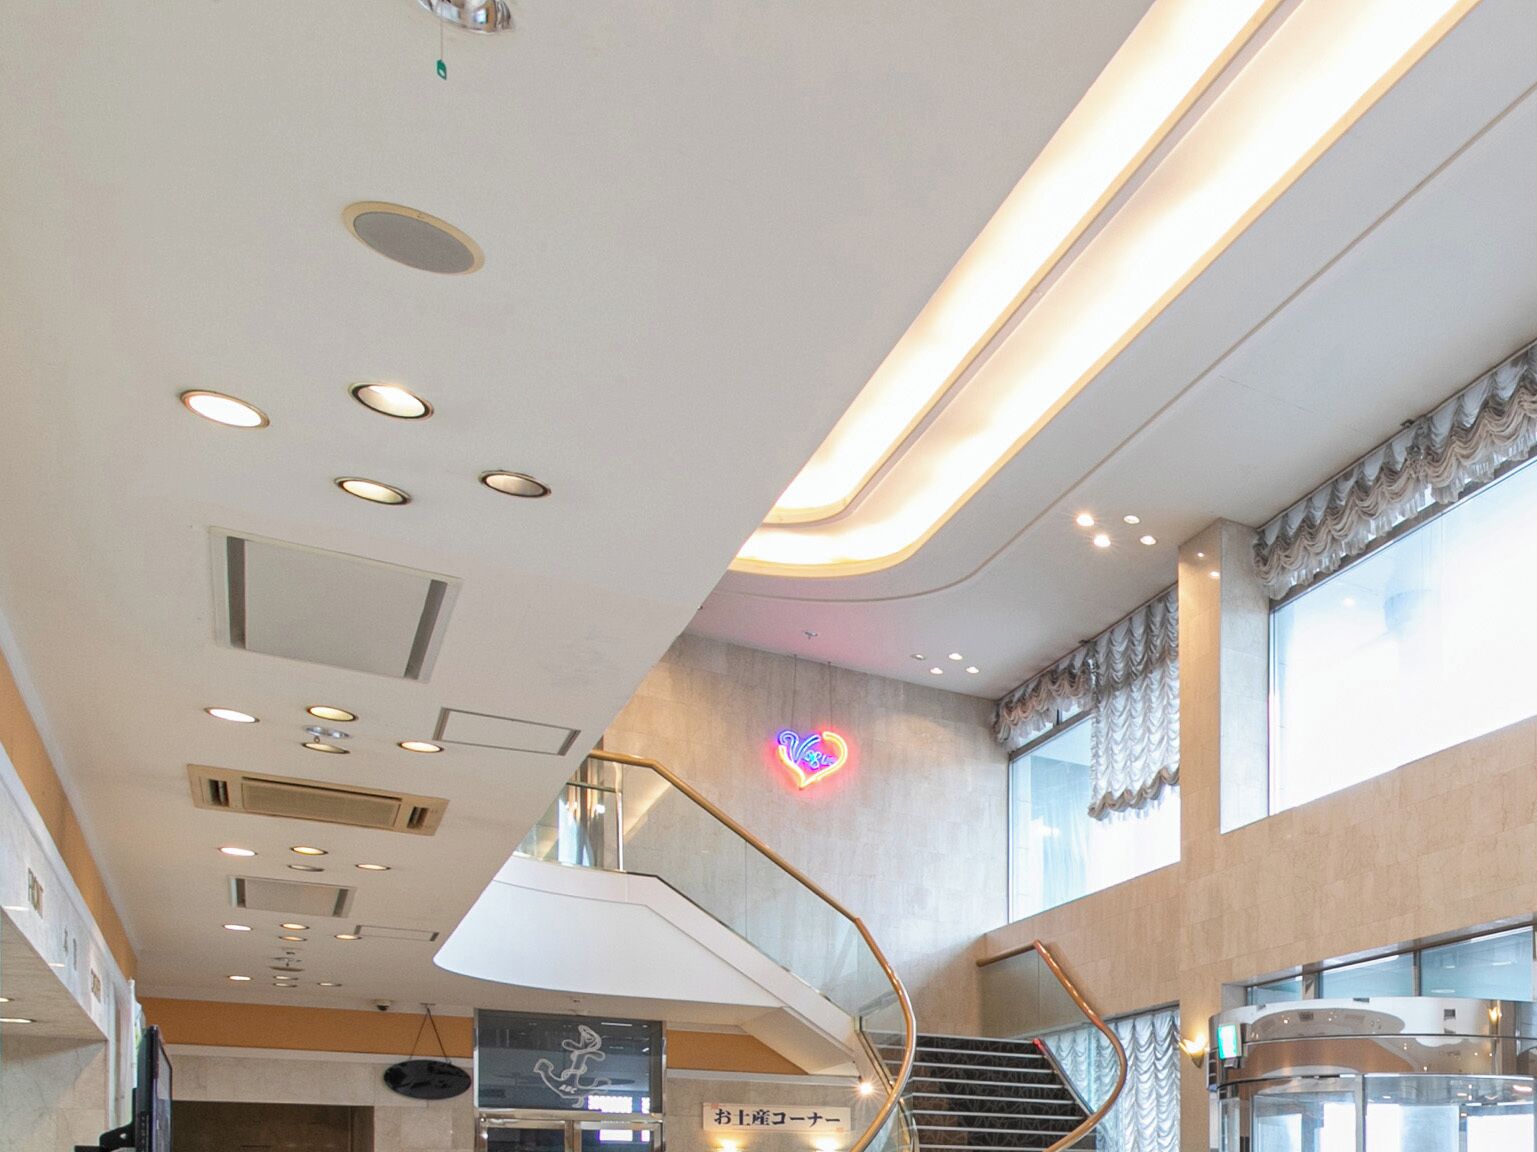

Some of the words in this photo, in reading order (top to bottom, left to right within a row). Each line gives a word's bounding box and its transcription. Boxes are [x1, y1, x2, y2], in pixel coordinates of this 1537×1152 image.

[714, 1108, 841, 1127] お土産コーナー
